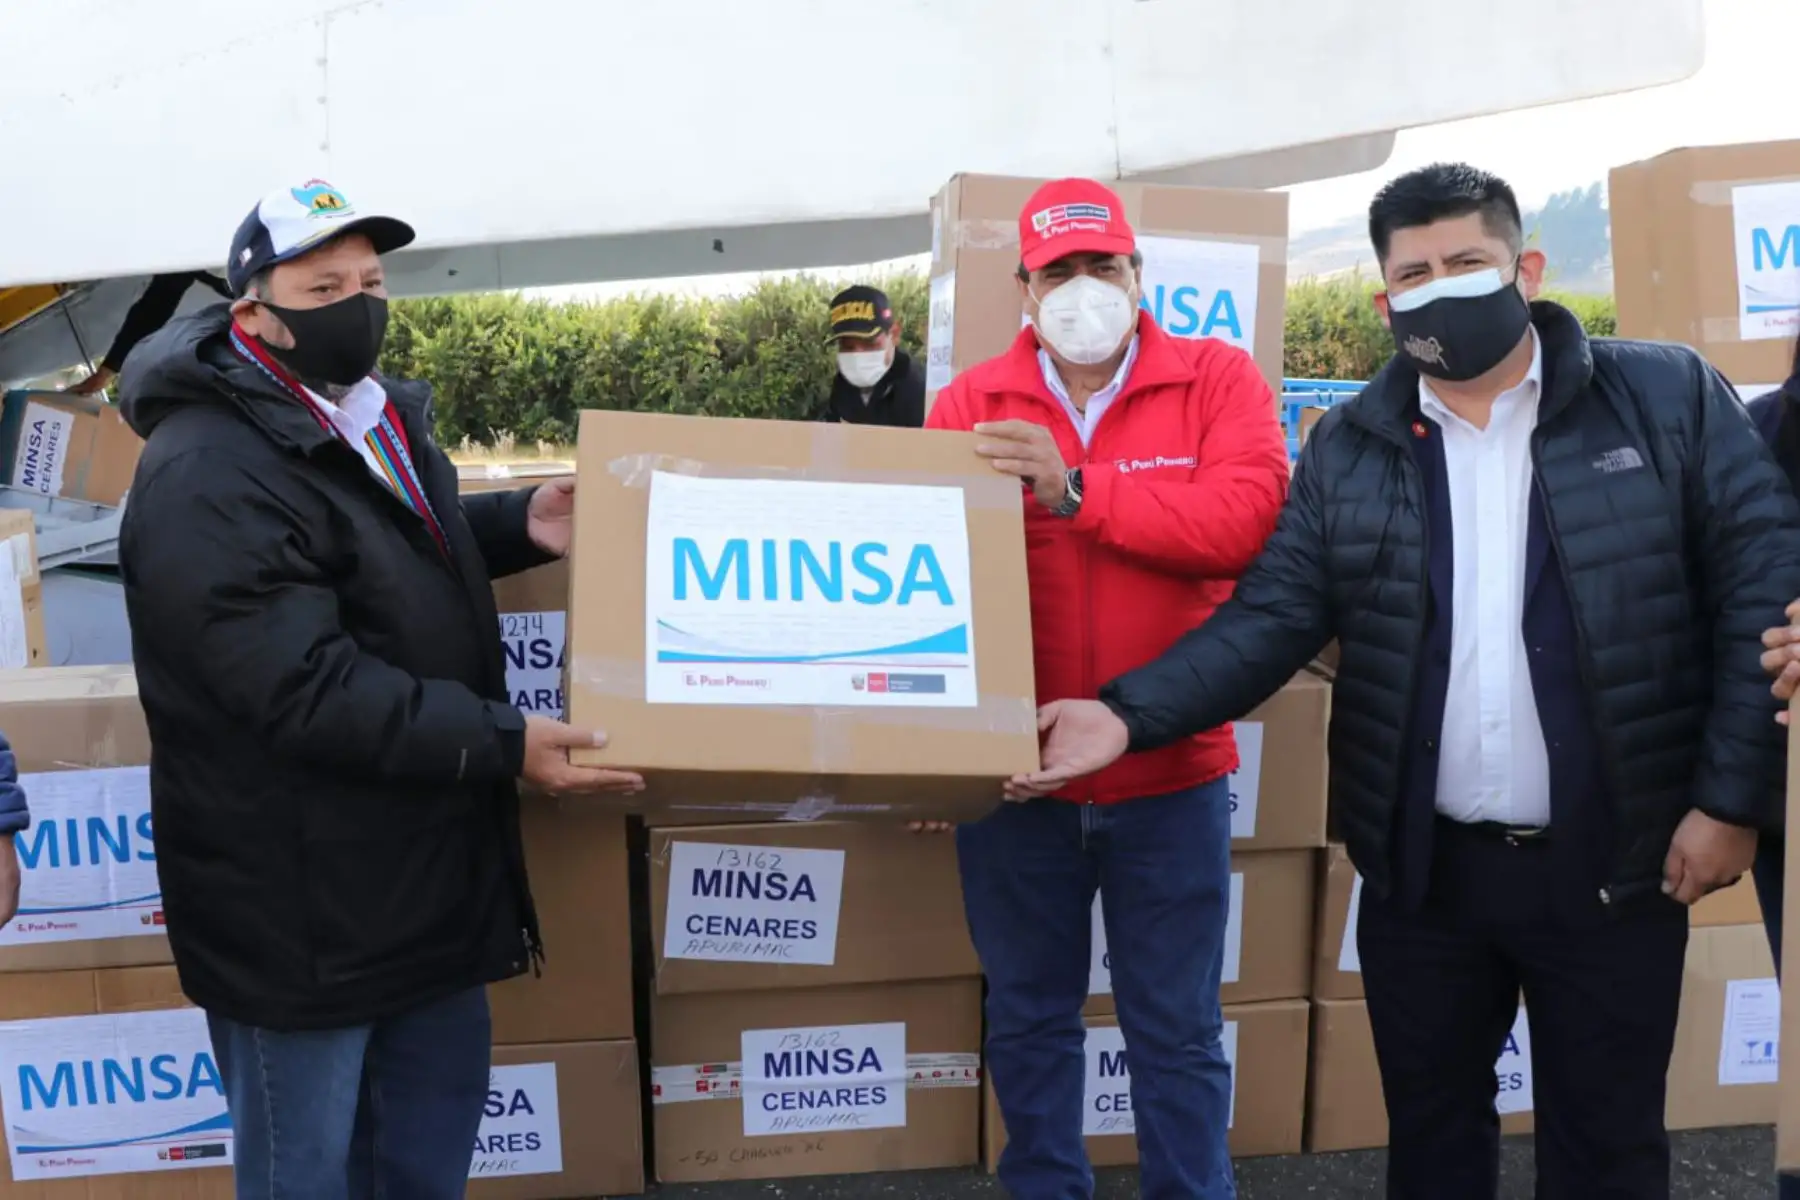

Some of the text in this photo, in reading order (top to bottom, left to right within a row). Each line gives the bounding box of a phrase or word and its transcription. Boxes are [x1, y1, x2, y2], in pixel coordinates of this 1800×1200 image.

[22, 420, 46, 487] MINSA
[40, 421, 61, 493] CENARES
[673, 537, 955, 606] MINSA
[717, 849, 783, 871] 13162
[692, 868, 817, 902] MINSA
[686, 914, 818, 940] CENARES
[778, 1031, 841, 1050] 13162
[764, 1047, 883, 1078] MINSA
[18, 1052, 226, 1111] MINSA
[762, 1086, 887, 1111] CENARES
